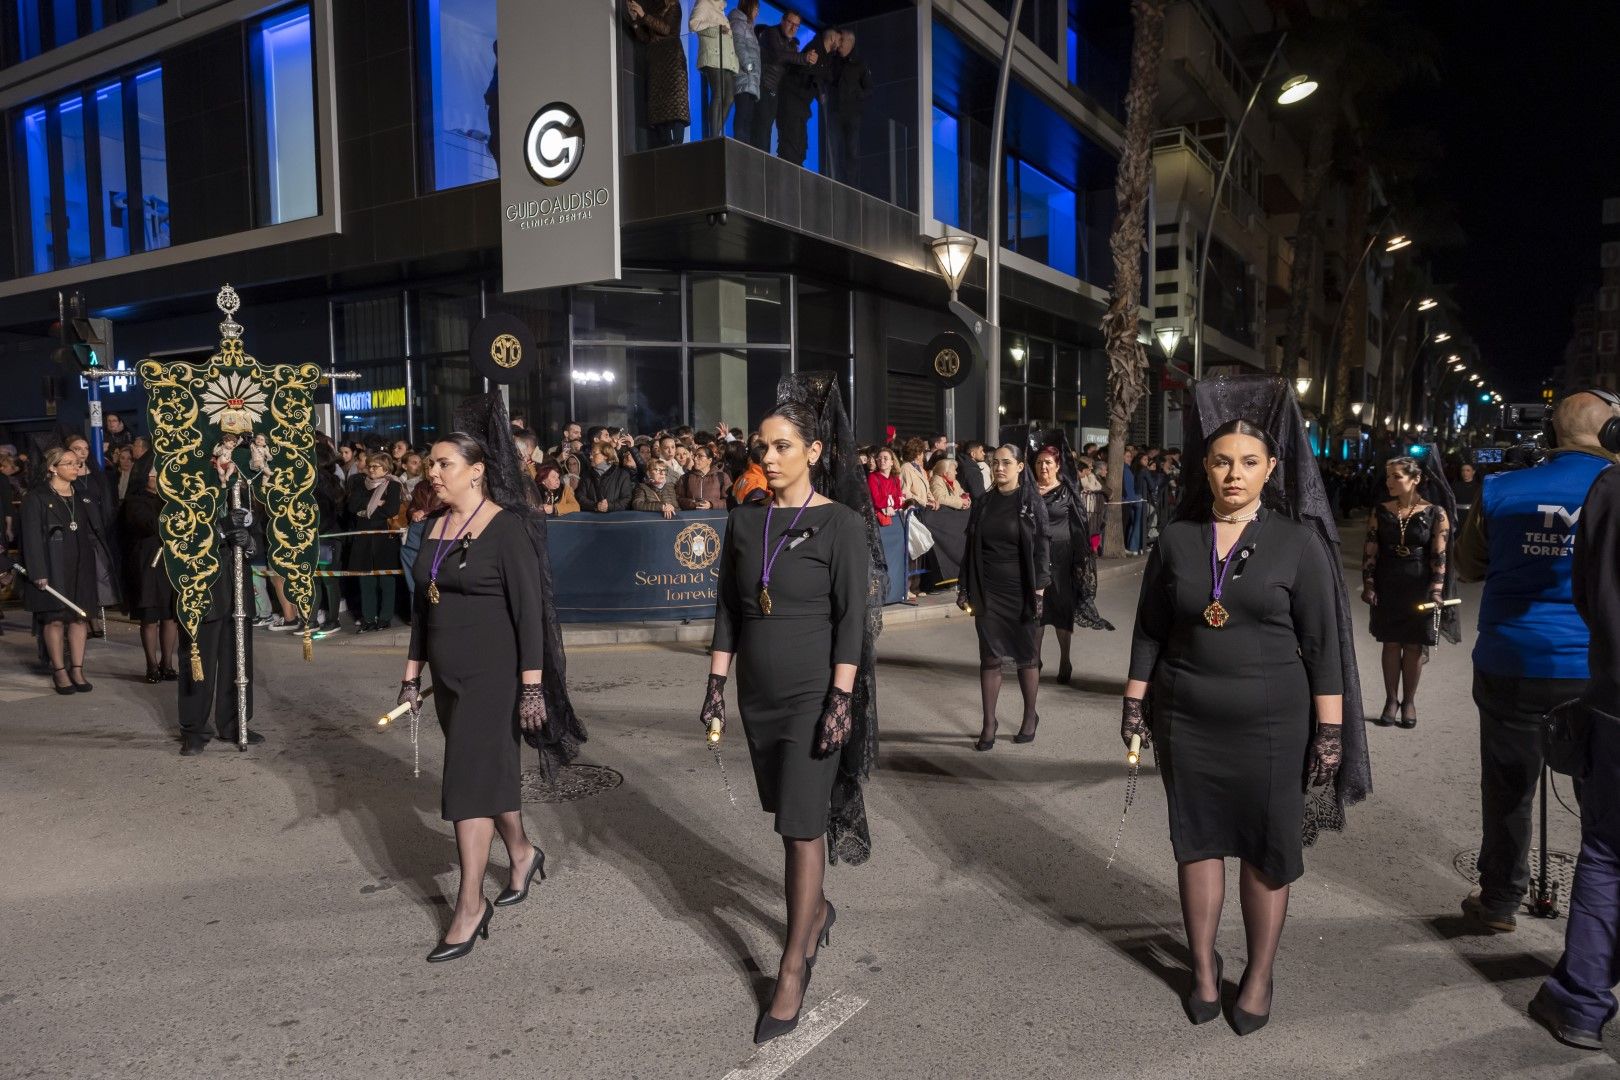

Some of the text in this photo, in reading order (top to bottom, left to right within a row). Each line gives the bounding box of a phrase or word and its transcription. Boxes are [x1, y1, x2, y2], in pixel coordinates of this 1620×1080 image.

[559, 210, 593, 224] DENTAL
[1537, 504, 1582, 528] TV
[1525, 532, 1576, 545] TELEVI
[635, 570, 704, 586] Semana
